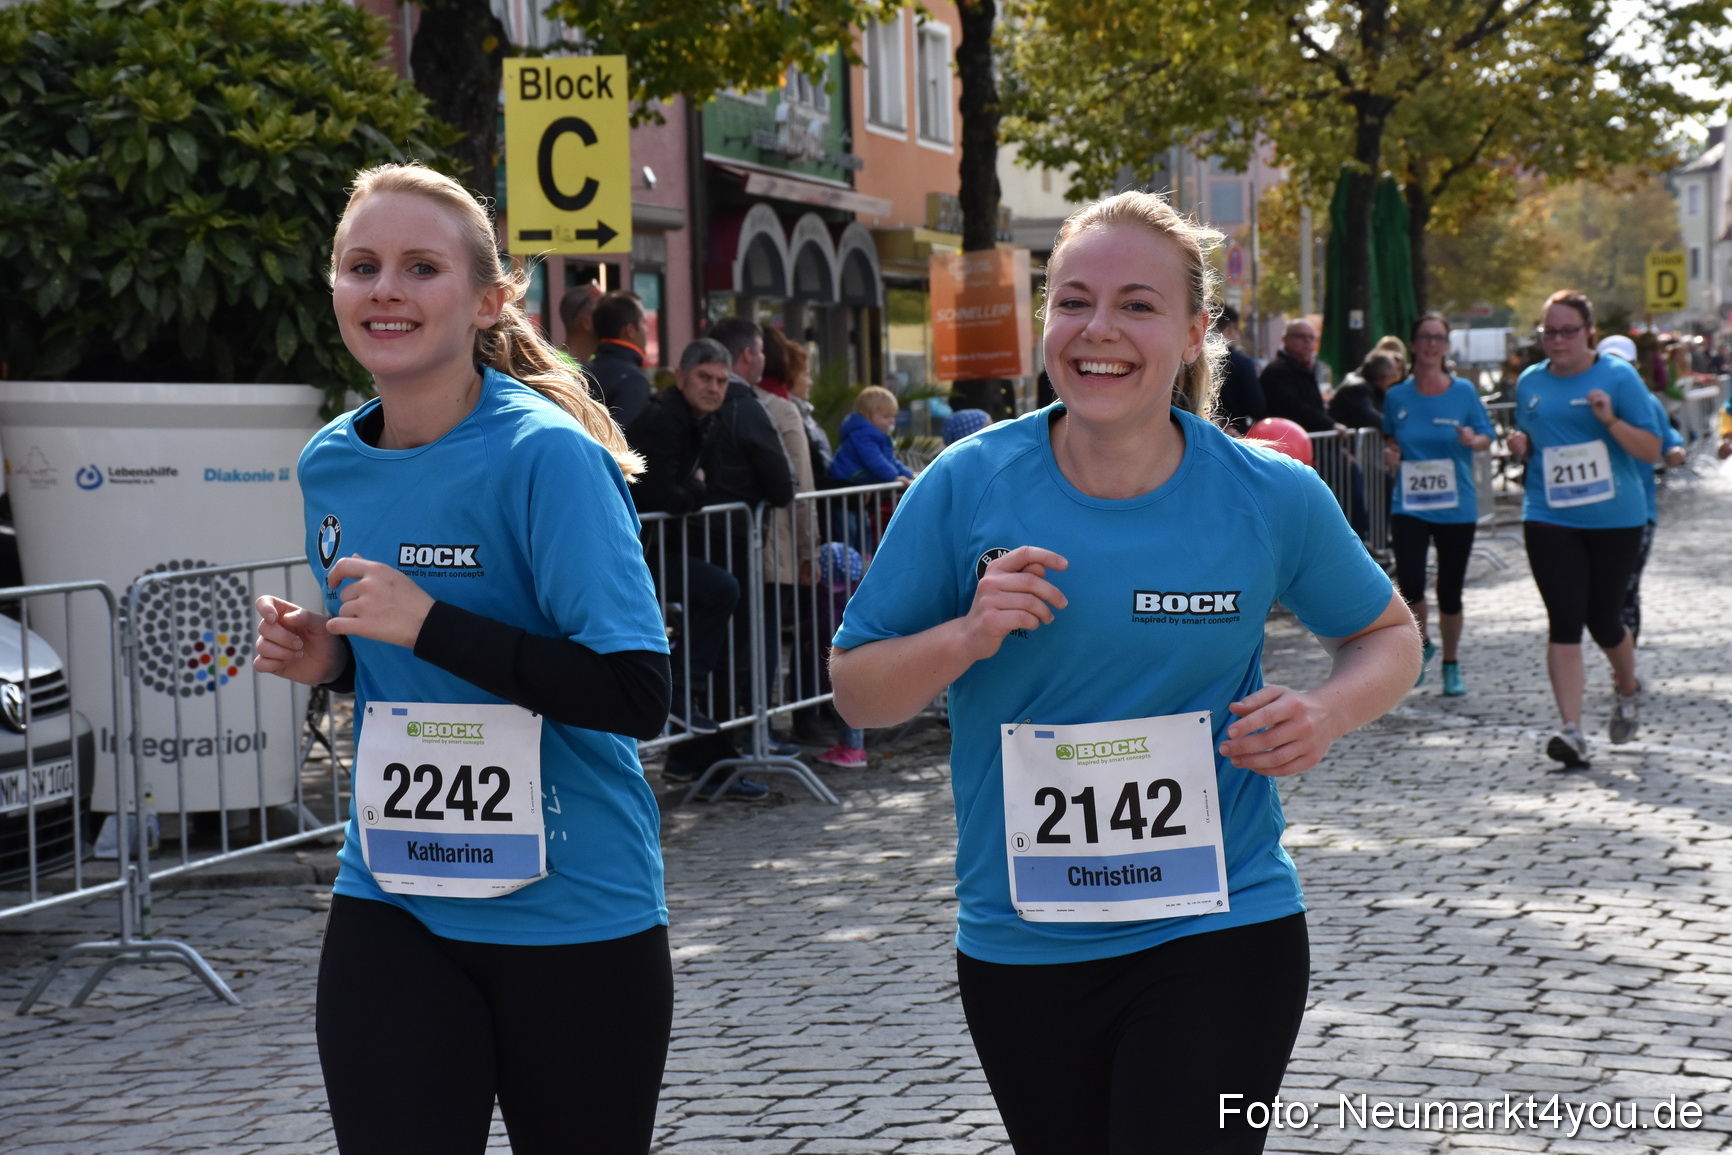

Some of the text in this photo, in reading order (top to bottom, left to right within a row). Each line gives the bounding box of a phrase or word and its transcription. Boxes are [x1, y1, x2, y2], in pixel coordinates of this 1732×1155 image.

[519, 66, 614, 101] Block
[537, 116, 600, 212] C
[1657, 270, 1679, 298] D
[107, 466, 178, 477] Lebenshilfe
[204, 468, 274, 482] Diakonie
[1409, 474, 1448, 491] 2476
[1553, 460, 1598, 483] 2111
[320, 517, 340, 534] BMW
[398, 543, 483, 569] BOCK
[449, 571, 485, 579] concepts
[1133, 590, 1241, 616] BOCK
[1132, 615, 1167, 624] inspired
[1169, 616, 1179, 625] by
[1208, 615, 1240, 624] concepts
[422, 722, 484, 739] BOCK
[101, 727, 267, 763] Itegraion
[1076, 737, 1149, 760] BOCK
[1126, 753, 1151, 761] concepts
[383, 763, 513, 822] 2242
[367, 810, 374, 821] D
[1034, 778, 1187, 844] 2142
[407, 841, 494, 863] Katharina
[1017, 837, 1024, 848] D
[1068, 864, 1162, 887] Christina
